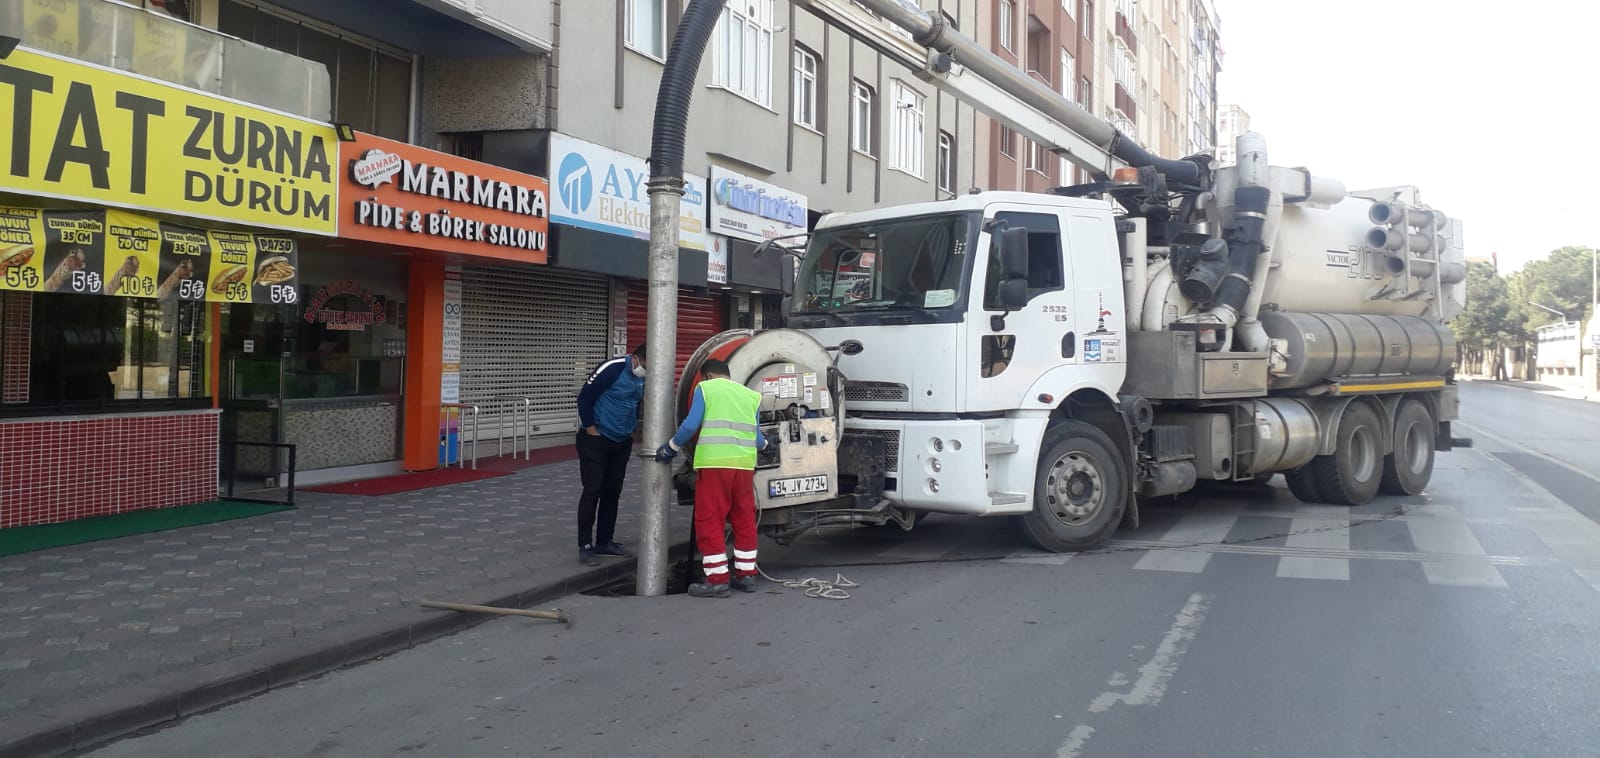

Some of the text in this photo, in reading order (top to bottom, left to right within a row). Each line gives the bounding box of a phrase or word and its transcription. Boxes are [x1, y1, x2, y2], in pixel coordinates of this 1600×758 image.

[182, 104, 332, 184] ZURNA
[357, 155, 400, 175] MARMARA
[400, 159, 548, 218] MARMARA
[600, 163, 651, 205] AY
[184, 166, 331, 222] DÜRÜM
[0, 217, 30, 230] AVUK
[49, 219, 103, 232] ZURNA DÜRÜM
[359, 197, 547, 252] PİDE & BÖREK SALONU
[0, 228, 33, 244] ÖNER
[62, 230, 92, 244] 35 CM
[110, 226, 133, 237] ZURNA
[118, 238, 148, 251] 70 CM
[173, 243, 201, 255] 35 CM
[1326, 254, 1350, 264] VACTOR
[708, 259, 727, 275] odafone
[1042, 305, 1067, 313] 2532
[1055, 314, 1067, 322] E5
[777, 478, 825, 493] 34 JV 2734
